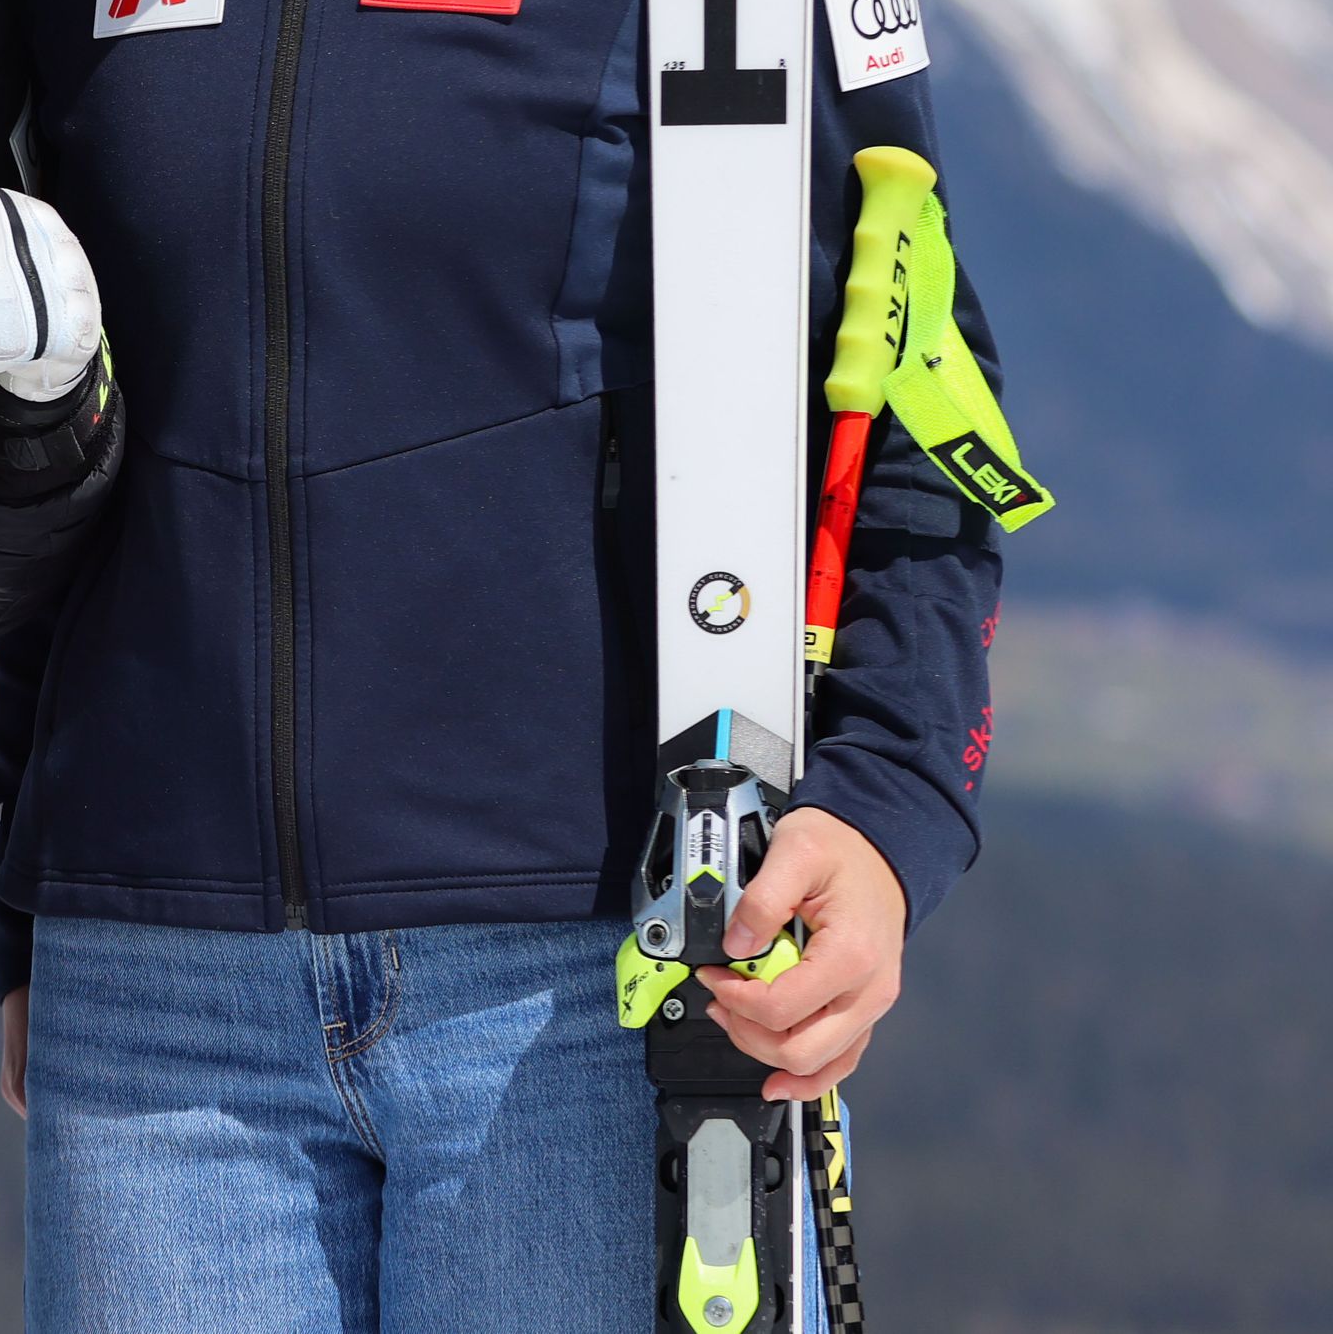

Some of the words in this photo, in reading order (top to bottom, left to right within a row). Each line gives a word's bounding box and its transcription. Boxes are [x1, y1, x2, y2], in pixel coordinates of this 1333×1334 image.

[866, 47, 905, 72] Audi
[885, 230, 911, 348] LEKI
[951, 442, 1021, 505] LEKI
